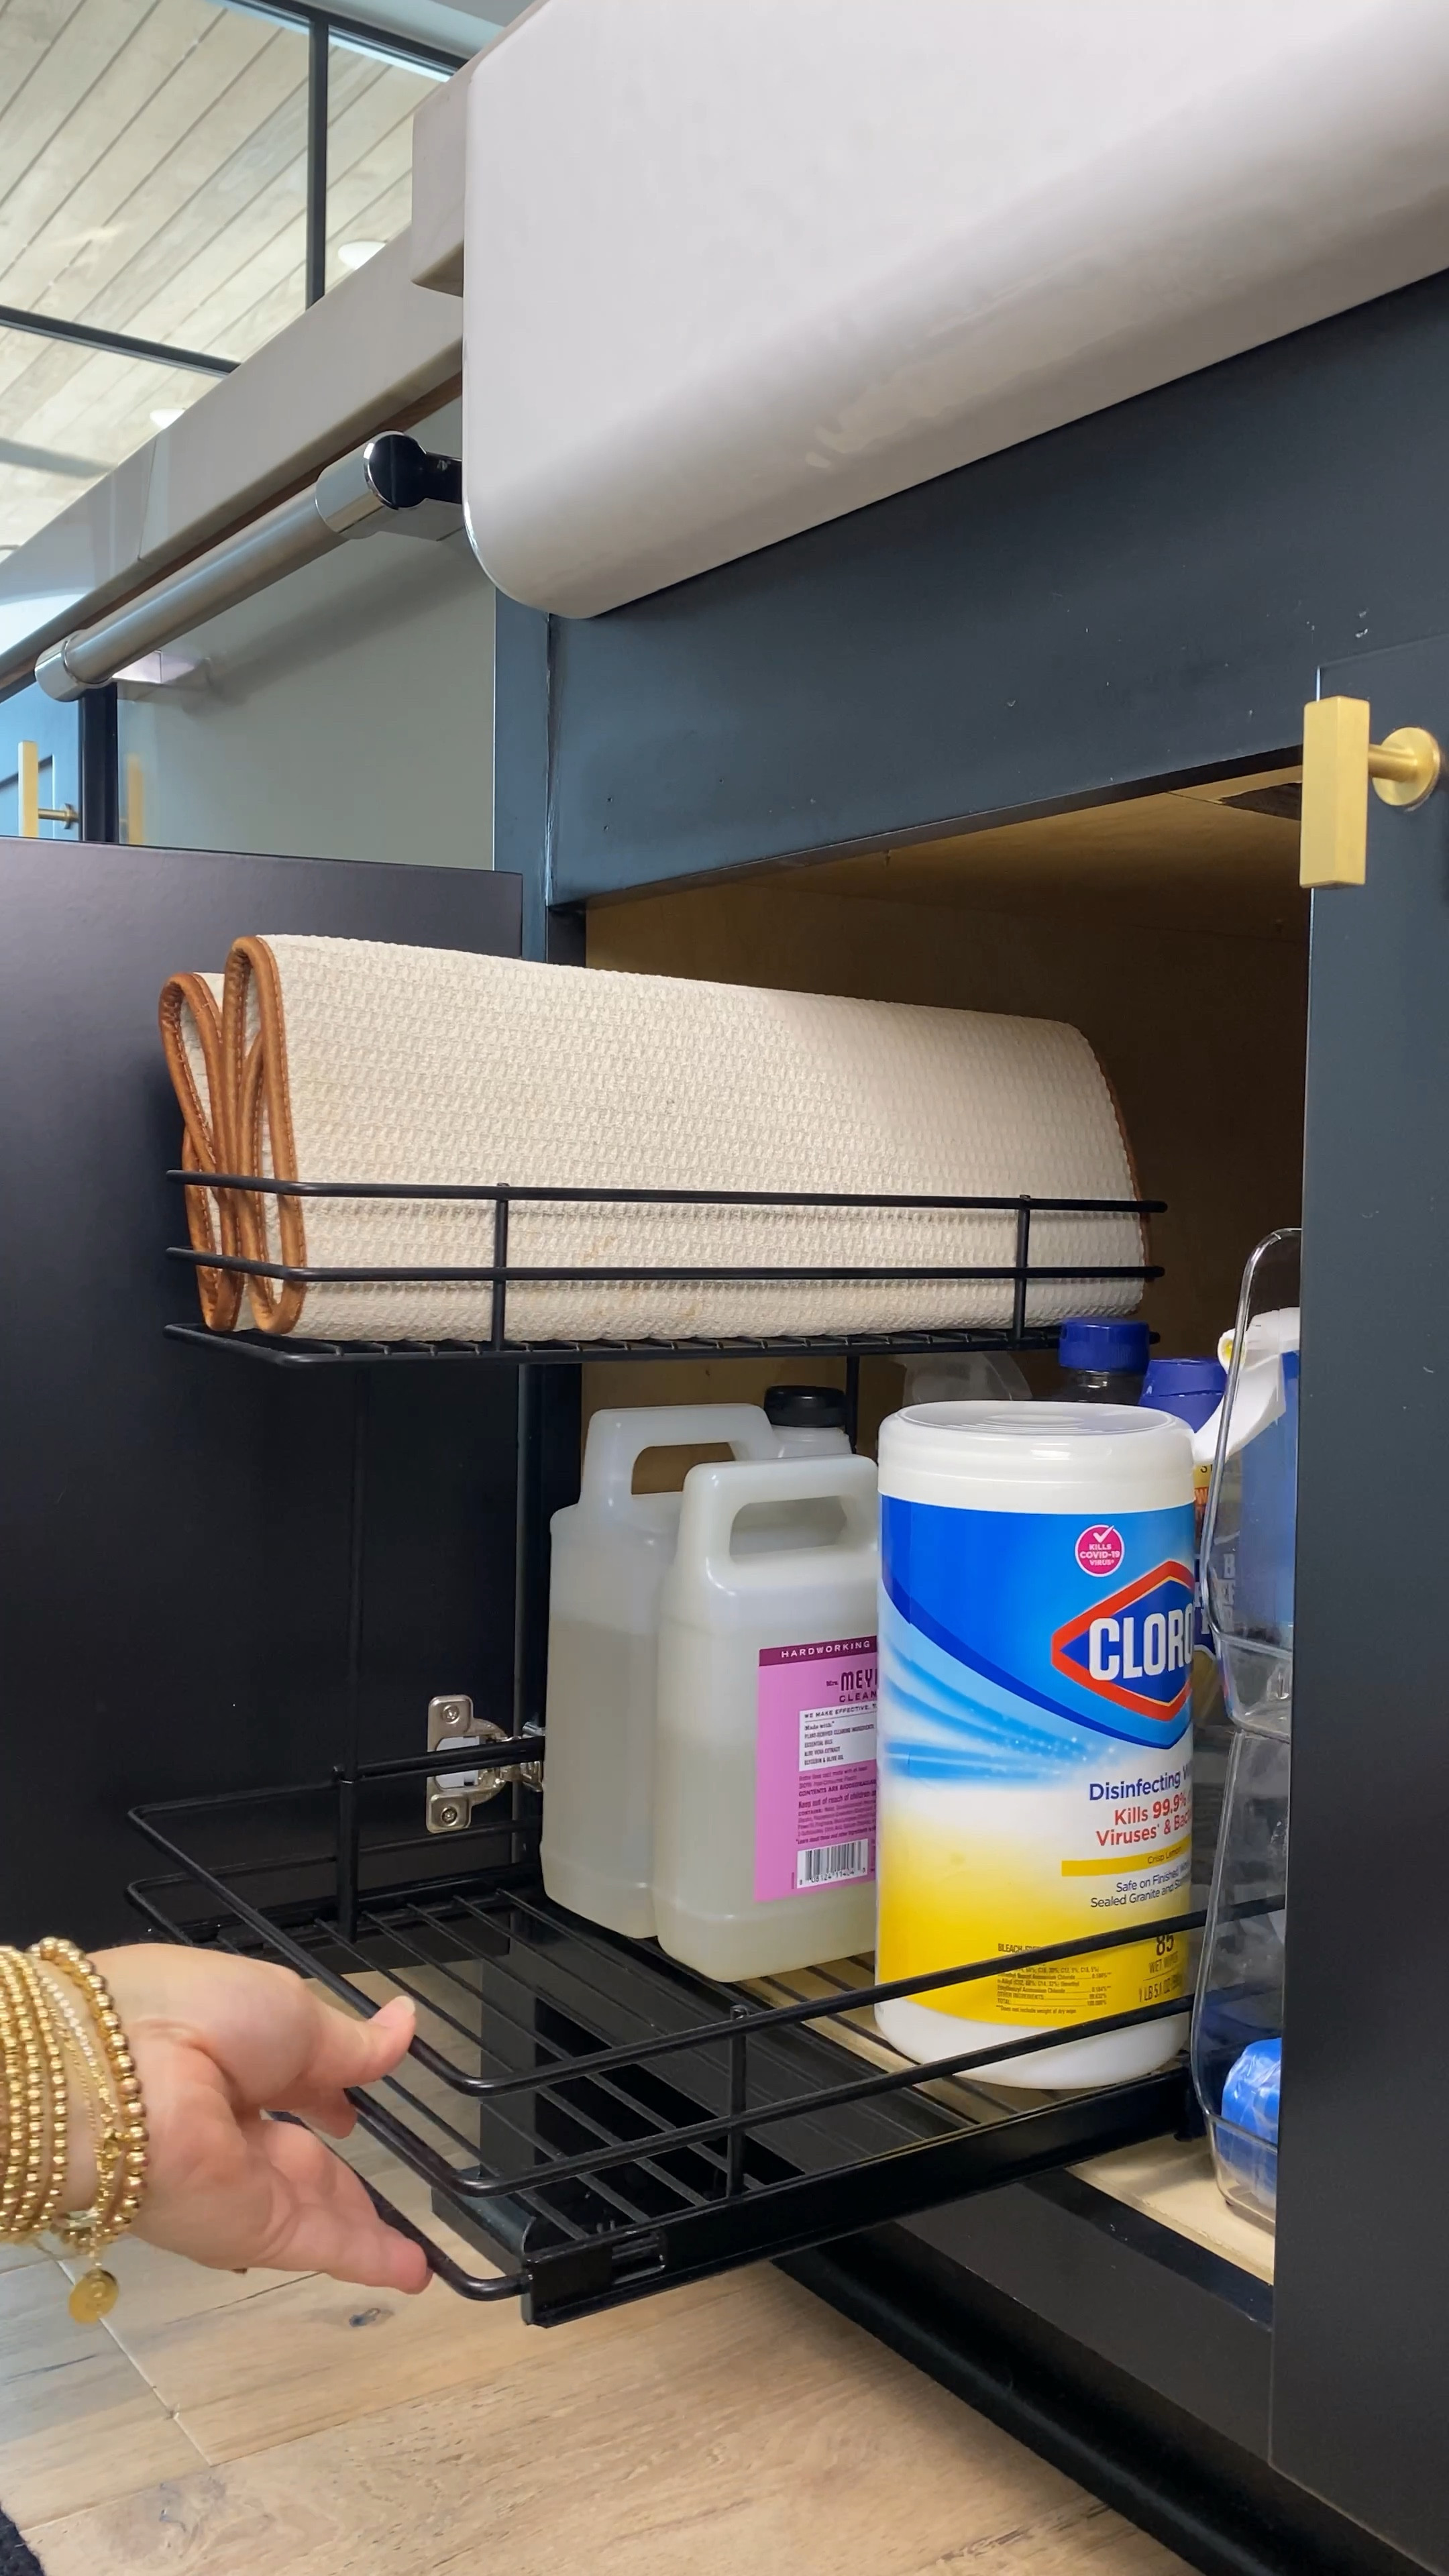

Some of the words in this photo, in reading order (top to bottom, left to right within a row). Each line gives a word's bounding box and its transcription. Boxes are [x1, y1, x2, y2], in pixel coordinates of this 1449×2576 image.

[1079, 1550, 1120, 1559] COVID-19
[781, 1640, 870, 1658] HARDWORKING
[839, 1690, 877, 1703] CLEAN
[799, 1786, 826, 1796] CONTENTS
[1089, 1770, 1181, 1801] Disinfecting
[1114, 1807, 1148, 1825] Kills
[1152, 1792, 1187, 1819] 99.9%
[1163, 1819, 1171, 1835] &
[1148, 1855, 1165, 1864] Crisp
[1116, 1880, 1137, 1892] Safe
[1140, 1878, 1150, 1888] on
[1091, 1894, 1127, 1908] Sealed
[1130, 1890, 1161, 1904] Granite
[1161, 1883, 1173, 1896] and
[1149, 1959, 1162, 1974] WET
